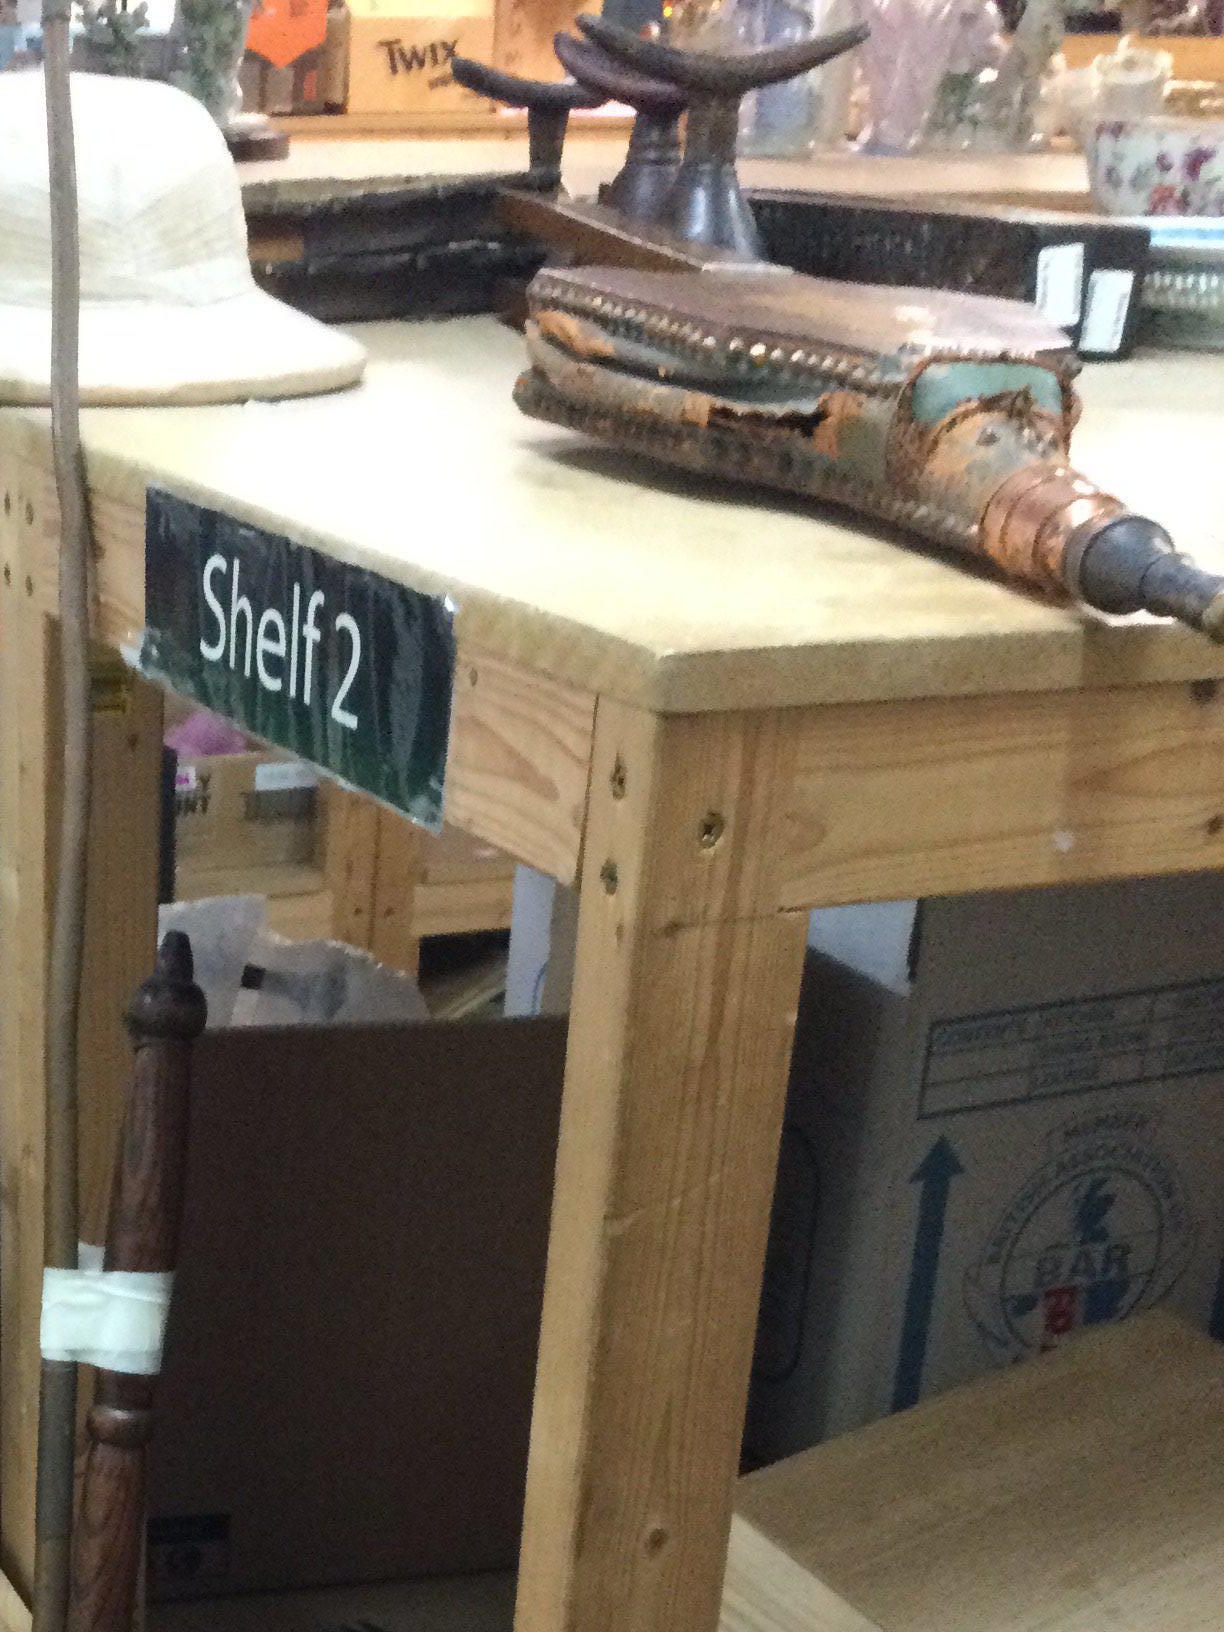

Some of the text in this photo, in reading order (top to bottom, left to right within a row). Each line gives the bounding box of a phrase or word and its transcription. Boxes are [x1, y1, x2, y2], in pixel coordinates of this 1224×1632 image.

[200, 554, 361, 731] Shelf 2
[1034, 1242, 1132, 1288] BAR
